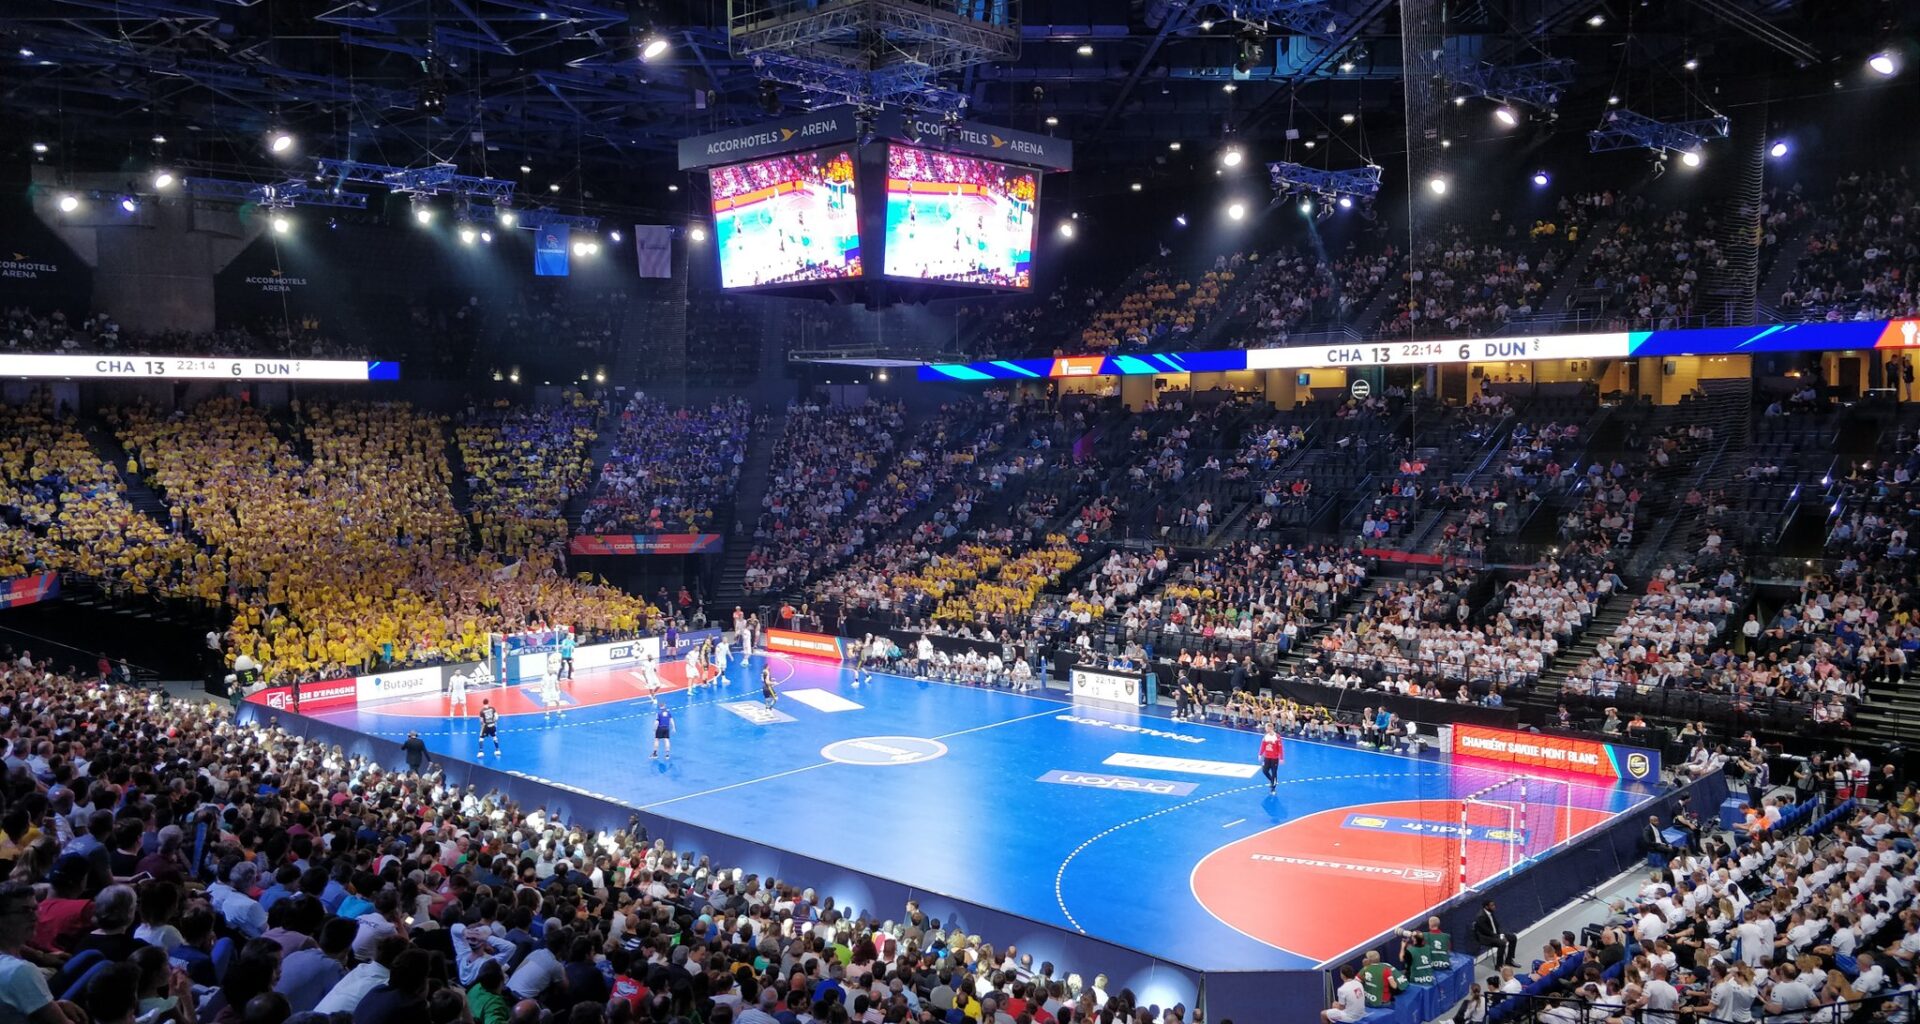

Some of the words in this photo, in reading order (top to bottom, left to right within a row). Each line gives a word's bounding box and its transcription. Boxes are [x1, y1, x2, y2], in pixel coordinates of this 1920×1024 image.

[801, 119, 837, 137] ARENA
[1011, 140, 1044, 155] ARENA
[2, 270, 37, 278] ARENA
[1327, 349, 1362, 362] CHA
[1371, 348, 1391, 363] 13
[1402, 344, 1442, 356] 22:14
[1459, 344, 1470, 360] 6
[1485, 342, 1526, 357] DUN
[96, 361, 135, 373] CHA
[145, 361, 165, 375] 13
[177, 361, 216, 370] 22:14
[231, 363, 242, 375] 6
[255, 364, 290, 375] DUN
[611, 648, 628, 659] FDJ
[383, 678, 423, 690] Butagaz
[286, 691, 312, 702] CSSE
[313, 686, 355, 697] D'EPARGNE
[1462, 736, 1506, 751] CHAMBÉRY
[1507, 742, 1540, 756] SAVOIE
[1541, 747, 1567, 760] MONT
[1567, 751, 1599, 765] BLANC
